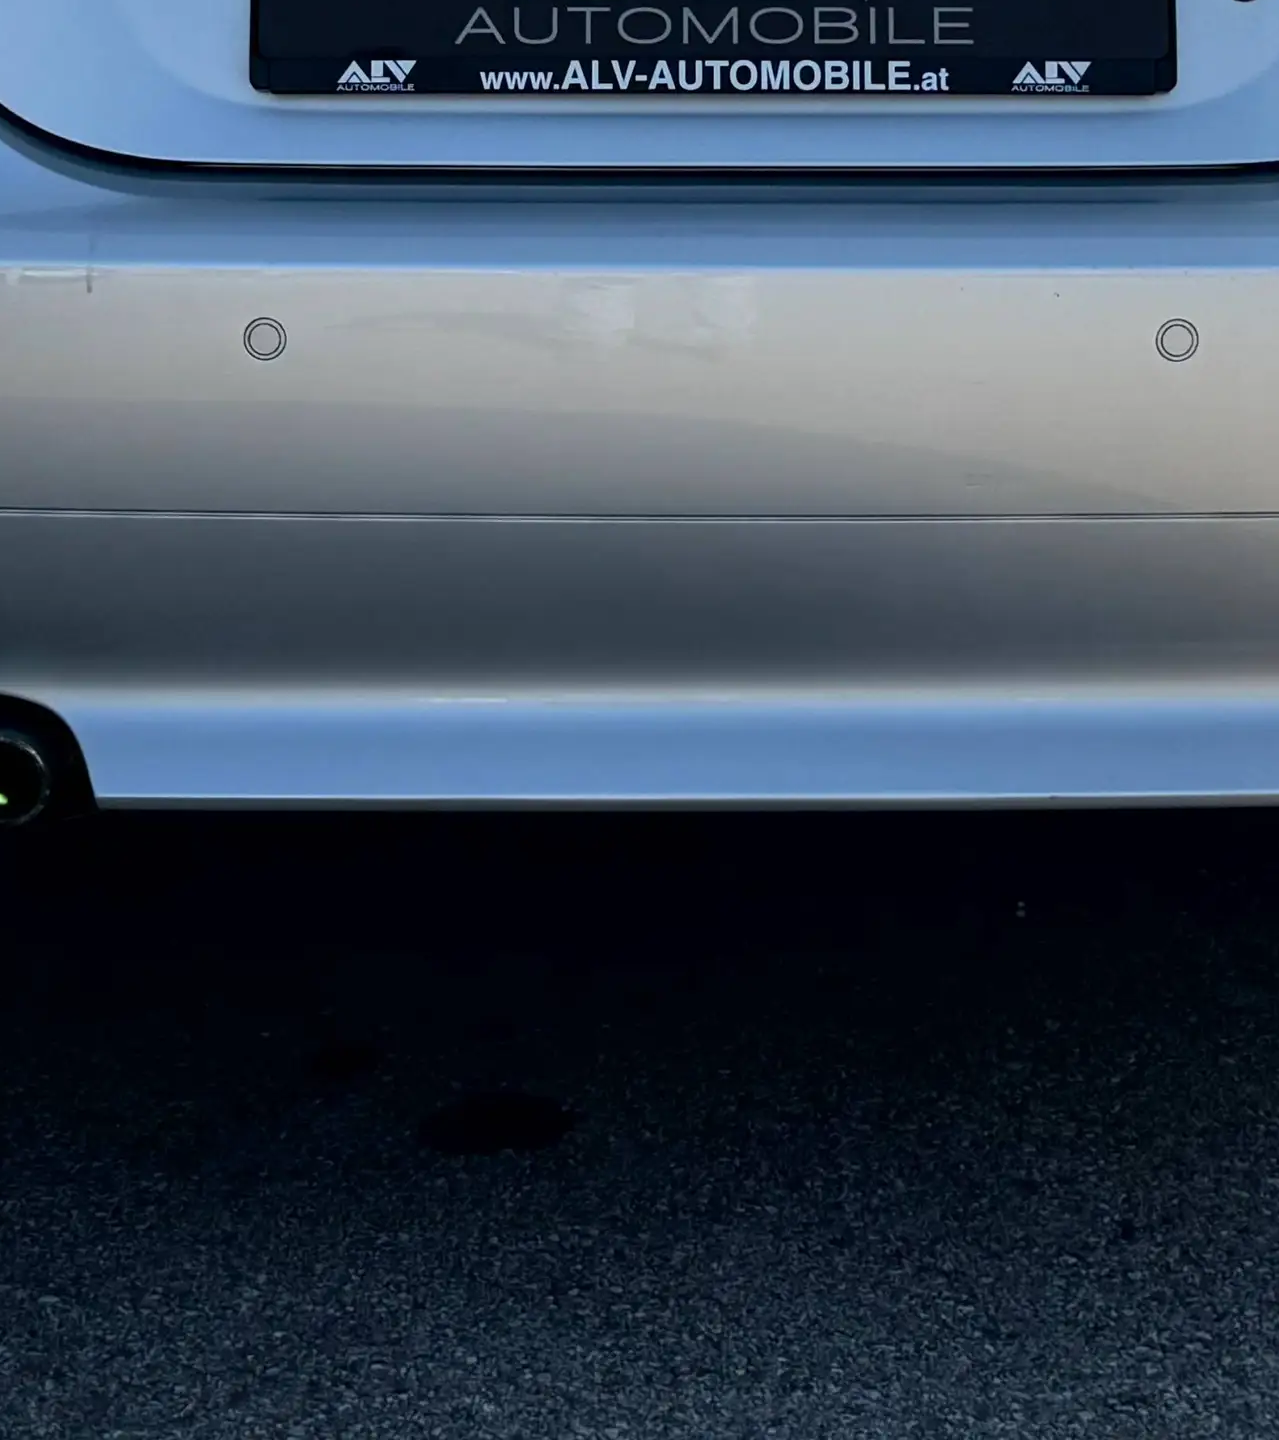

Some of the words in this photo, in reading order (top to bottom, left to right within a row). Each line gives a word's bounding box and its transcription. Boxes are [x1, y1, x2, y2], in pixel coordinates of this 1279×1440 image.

[454, 6, 975, 46] AUTOMOBILE
[336, 59, 418, 84] ALV
[479, 59, 950, 92] www.ALV-AUTOMOBILE.at
[1012, 60, 1093, 85] ALV
[336, 83, 416, 92] AUTOMOBILE
[1010, 84, 1091, 93] AUTOMOBILE
